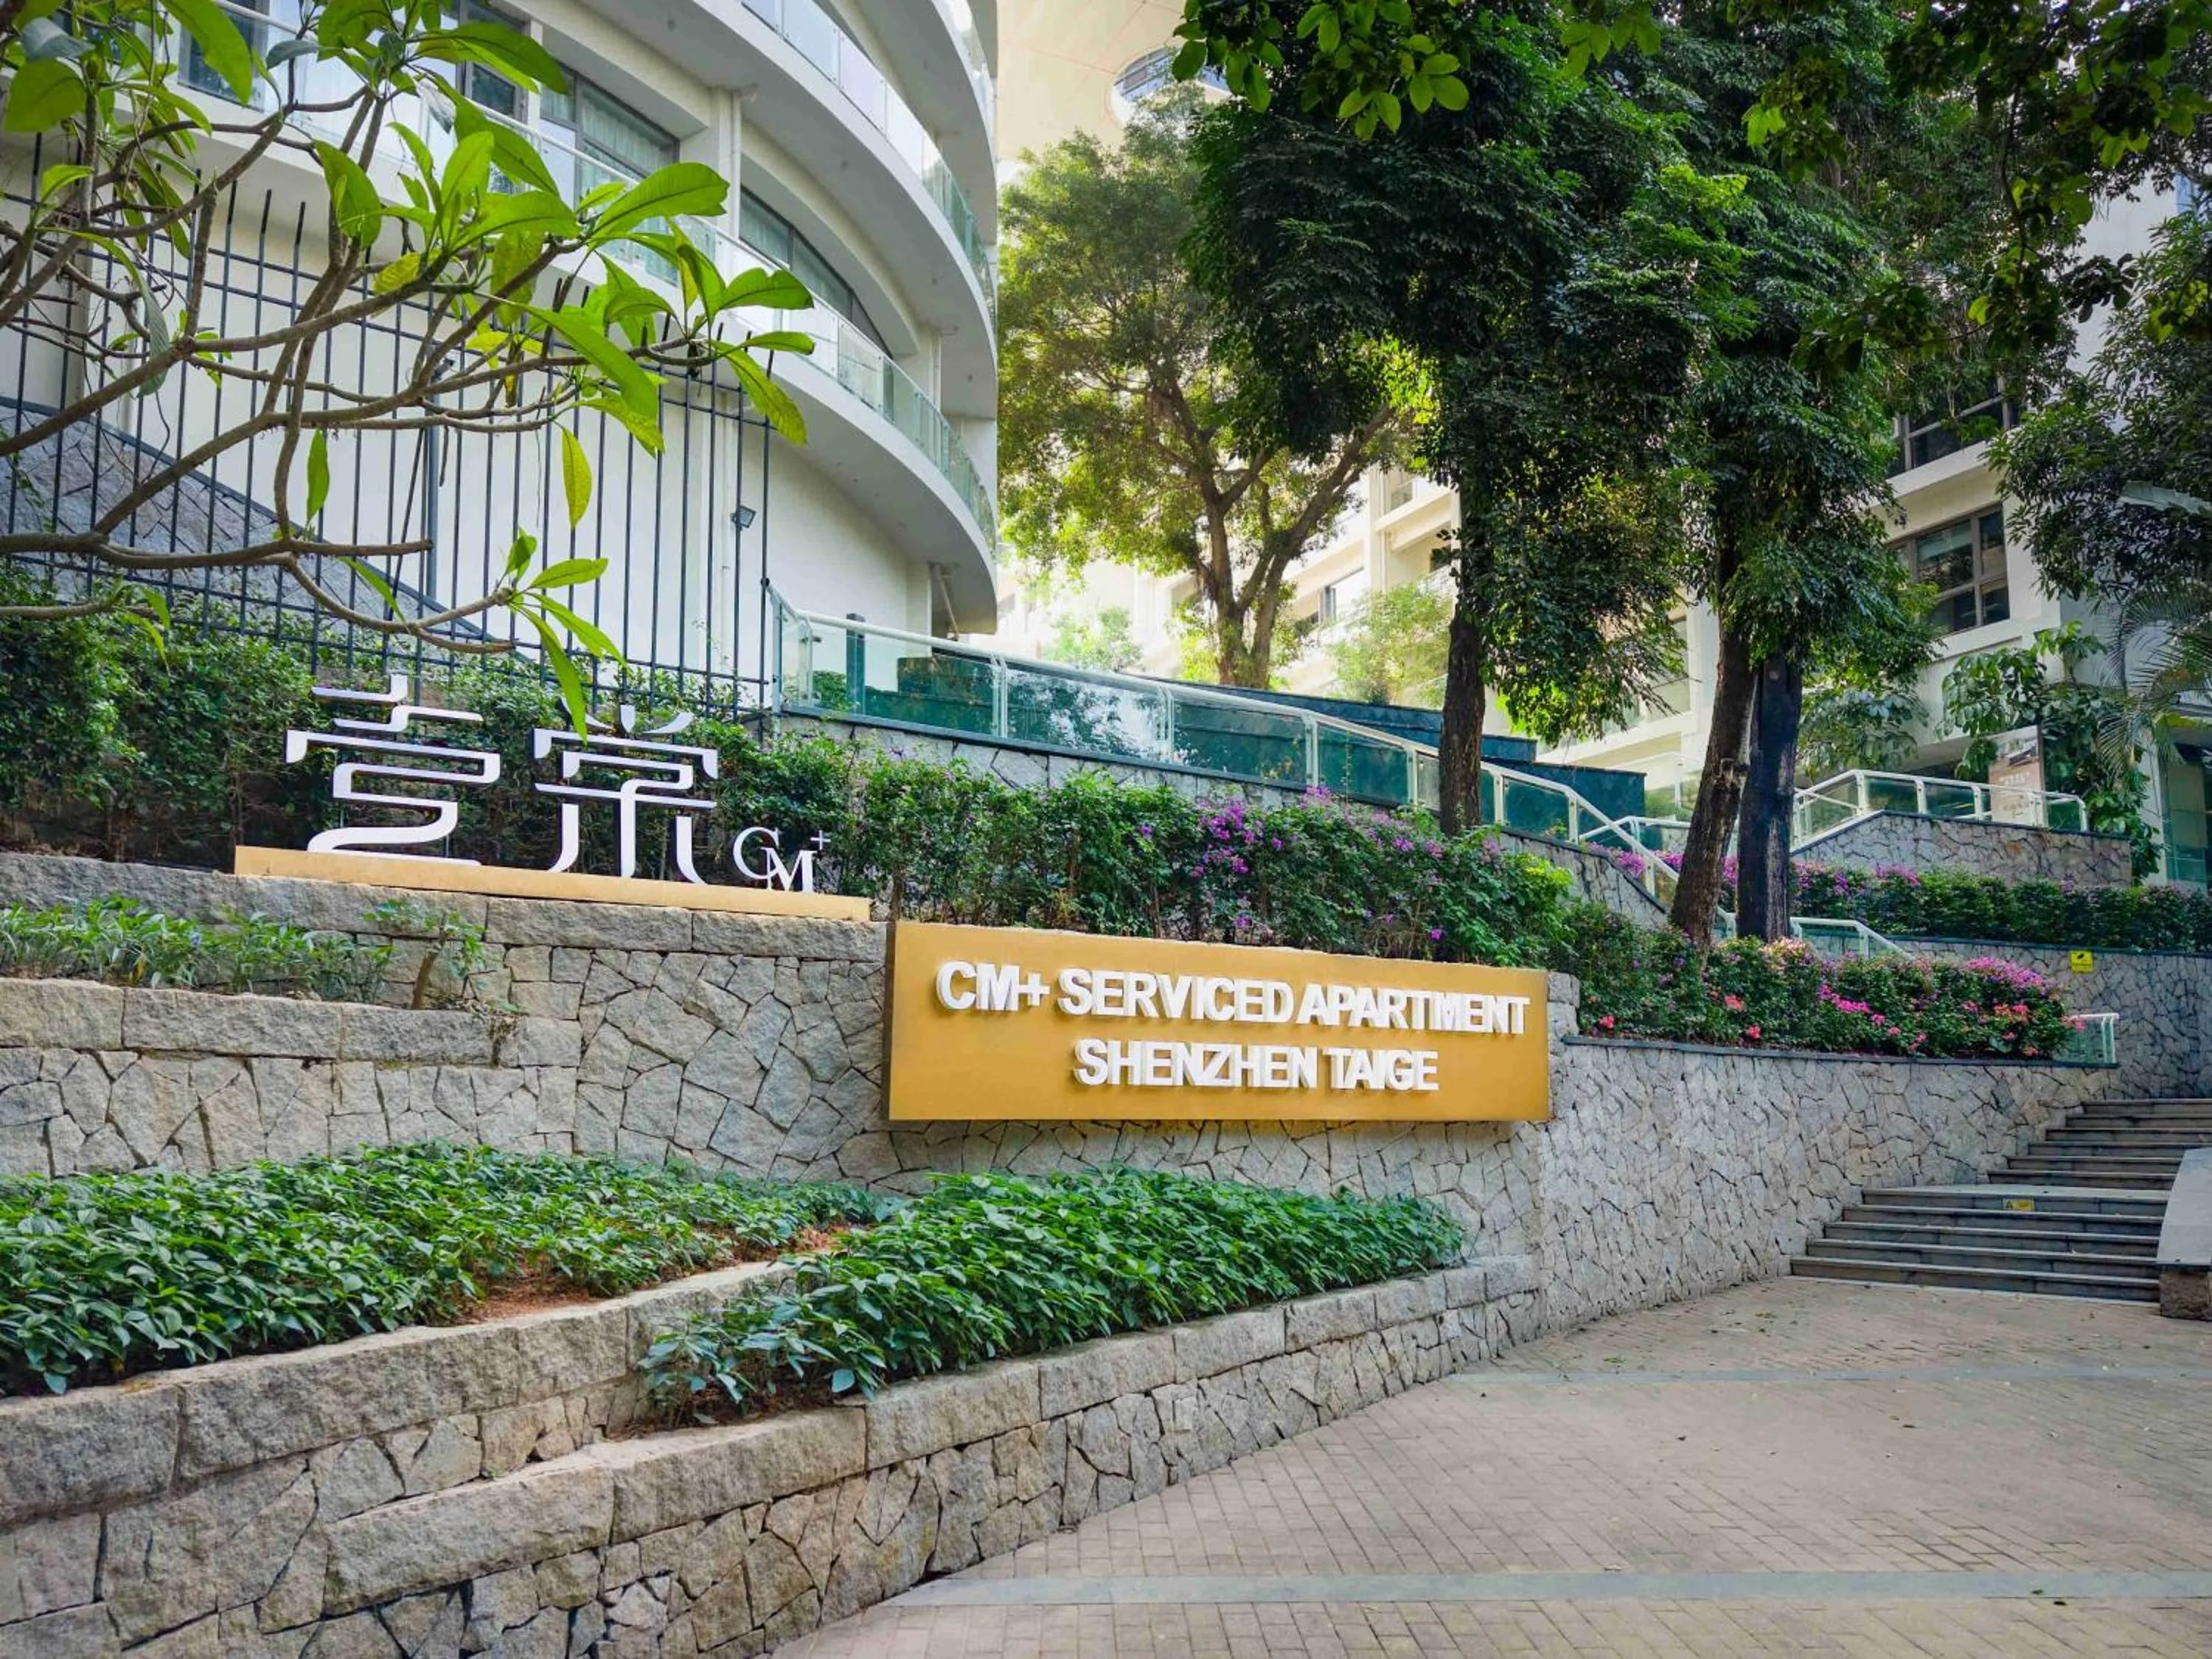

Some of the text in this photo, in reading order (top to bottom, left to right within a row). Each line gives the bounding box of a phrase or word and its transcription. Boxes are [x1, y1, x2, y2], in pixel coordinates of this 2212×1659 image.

[936, 961, 1530, 1034] CM+ SERVICED APARTMENT
[1074, 1038, 1439, 1091] SHENZHEN TAIGE
